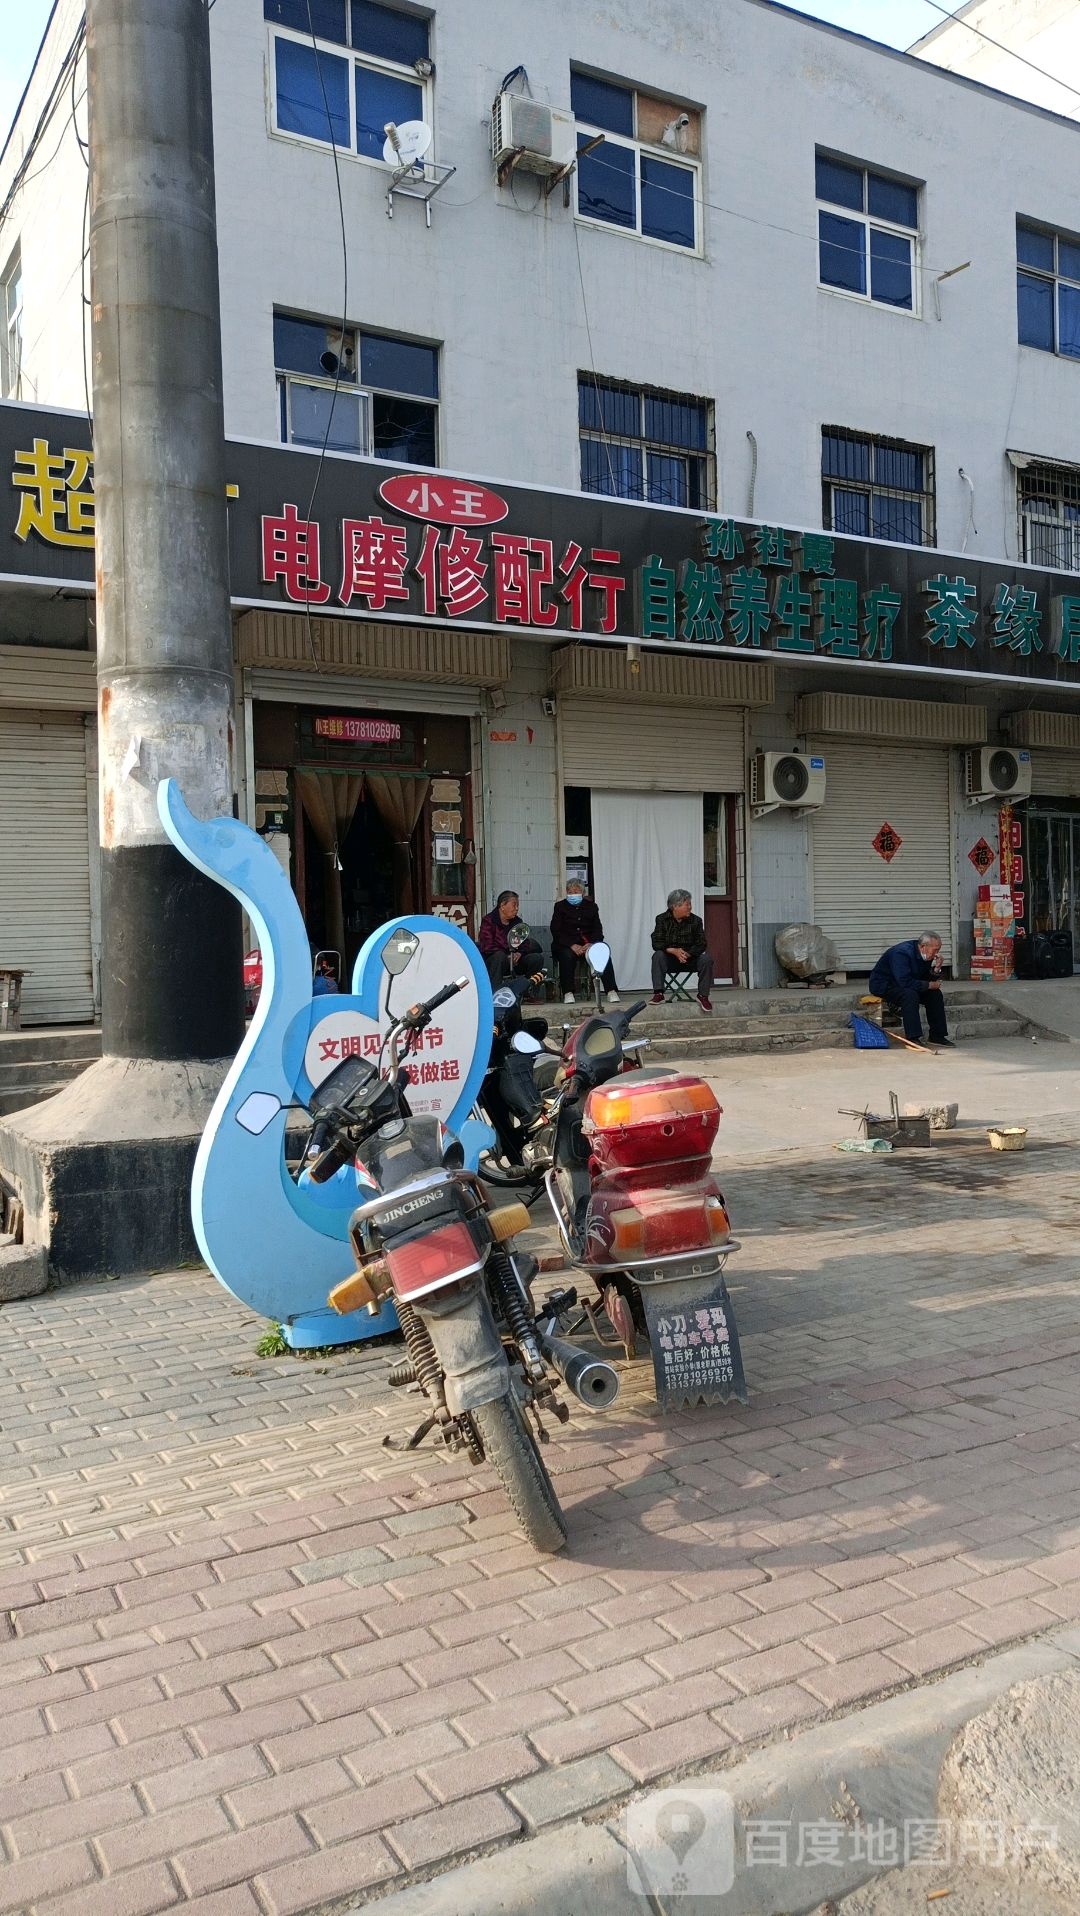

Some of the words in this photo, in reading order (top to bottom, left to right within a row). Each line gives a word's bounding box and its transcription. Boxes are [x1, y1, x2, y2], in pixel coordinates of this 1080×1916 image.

[406, 482, 486, 518] 小王
[705, 518, 836, 575] 孙社霞
[261, 504, 625, 633] 电摩修配行
[642, 554, 902, 661] 自然养生理疗
[315, 718, 344, 737] 小王维修
[345, 721, 400, 740] 13781026976
[879, 830, 895, 852] 福
[975, 847, 989, 866] 福
[383, 1189, 444, 1224] JINCHENG
[665, 1366, 733, 1383] 13781026976
[666, 1374, 732, 1389] 13137977507
